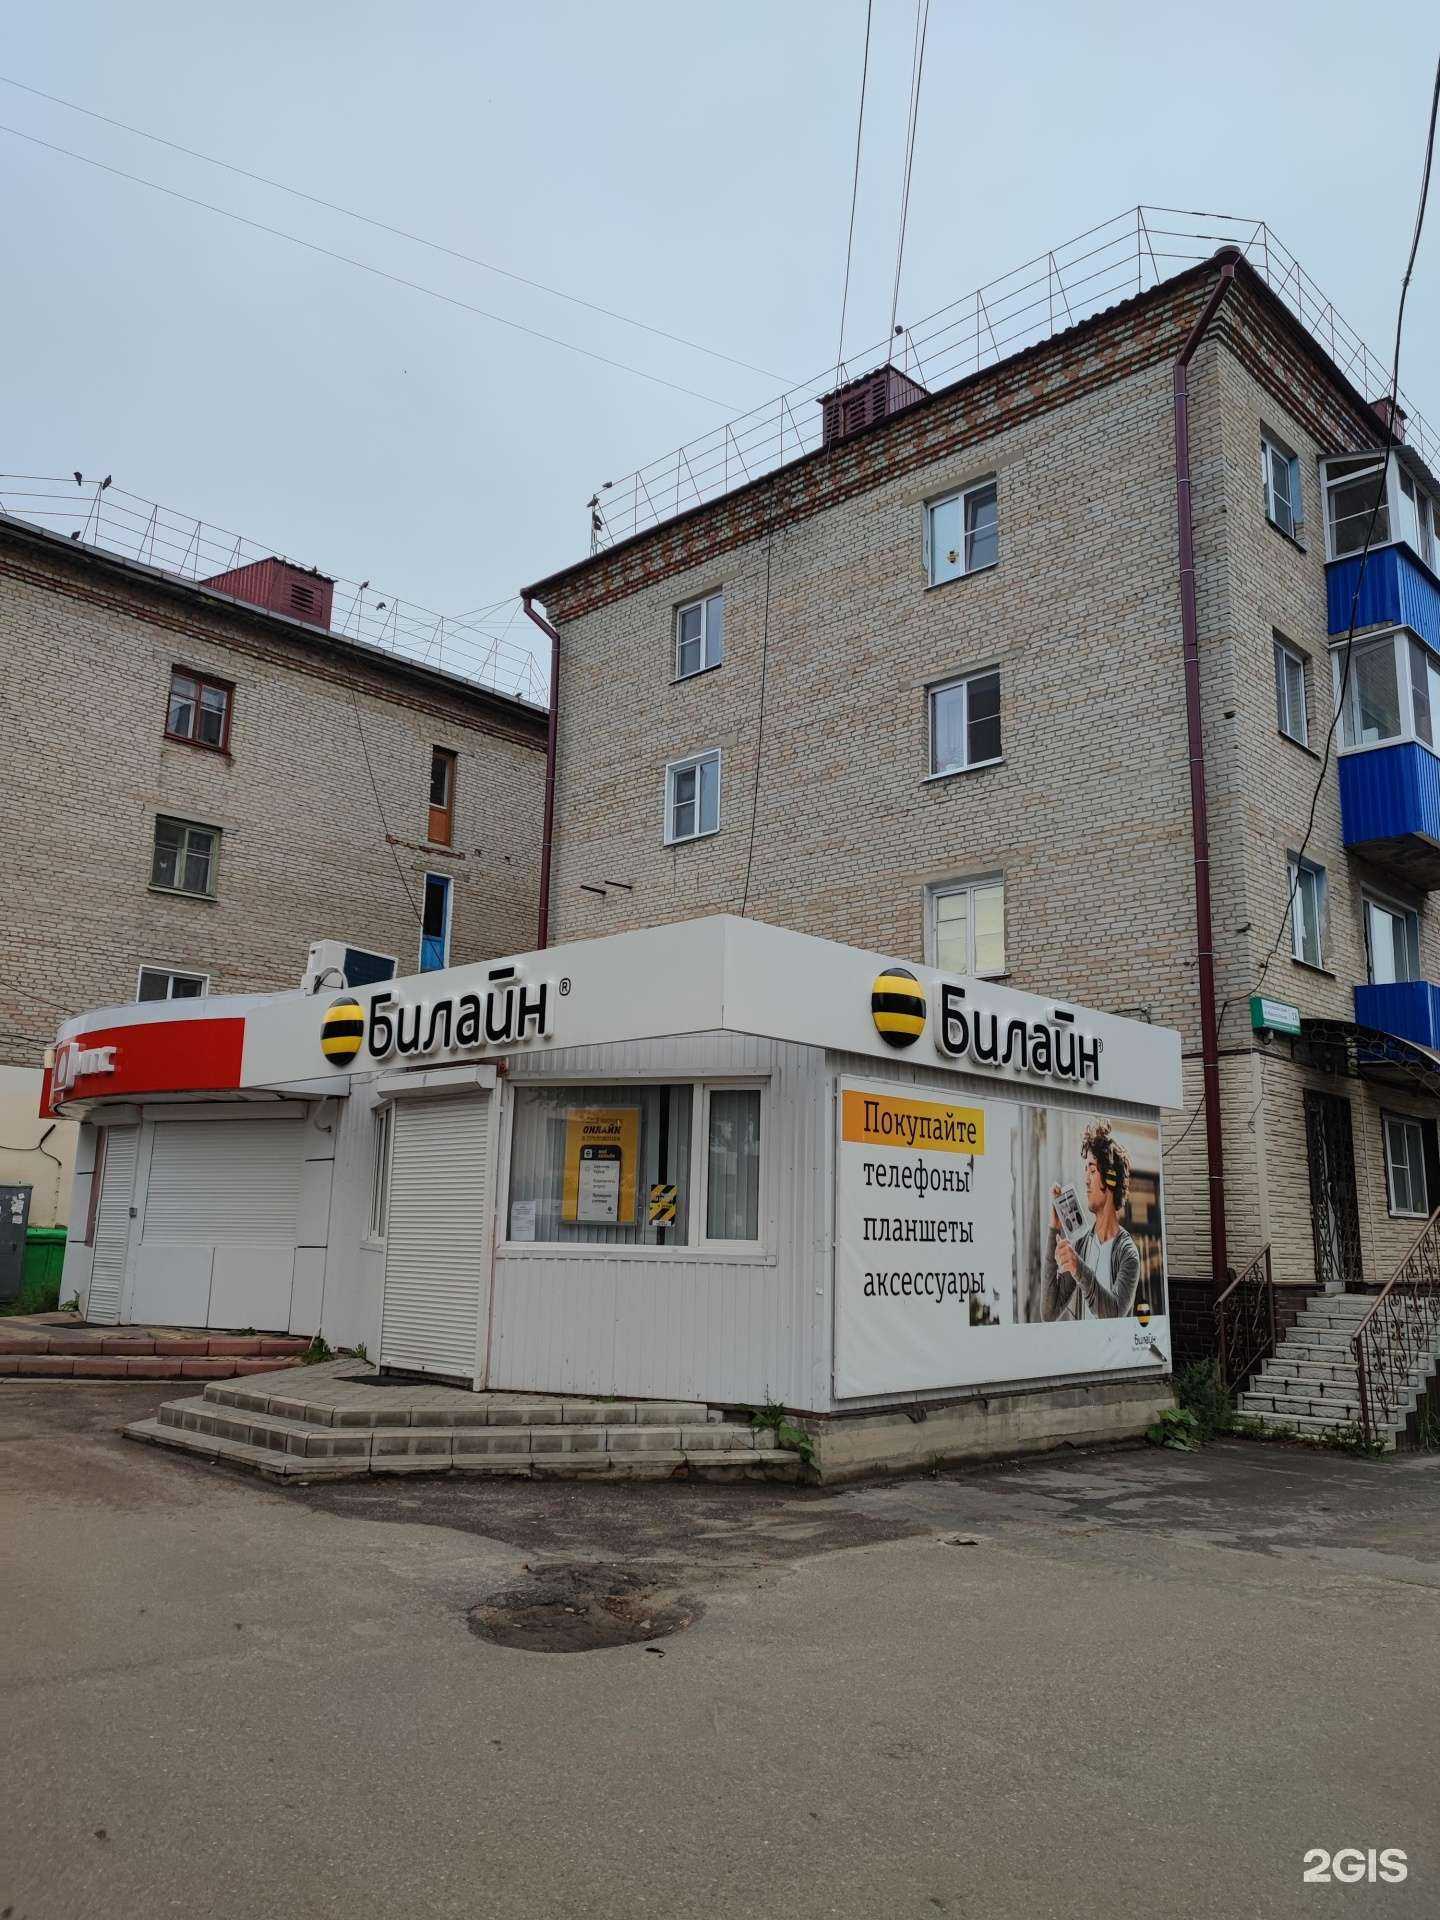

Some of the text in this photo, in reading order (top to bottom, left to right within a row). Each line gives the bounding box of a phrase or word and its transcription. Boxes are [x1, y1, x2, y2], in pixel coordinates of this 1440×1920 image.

[367, 966, 549, 1059] Билайн
[941, 983, 1099, 1082] Билайн
[863, 1100, 977, 1146] Покупайте
[863, 1158, 970, 1199] телефоны
[863, 1217, 974, 1243] планшеты
[863, 1271, 986, 1304] аксессуары
